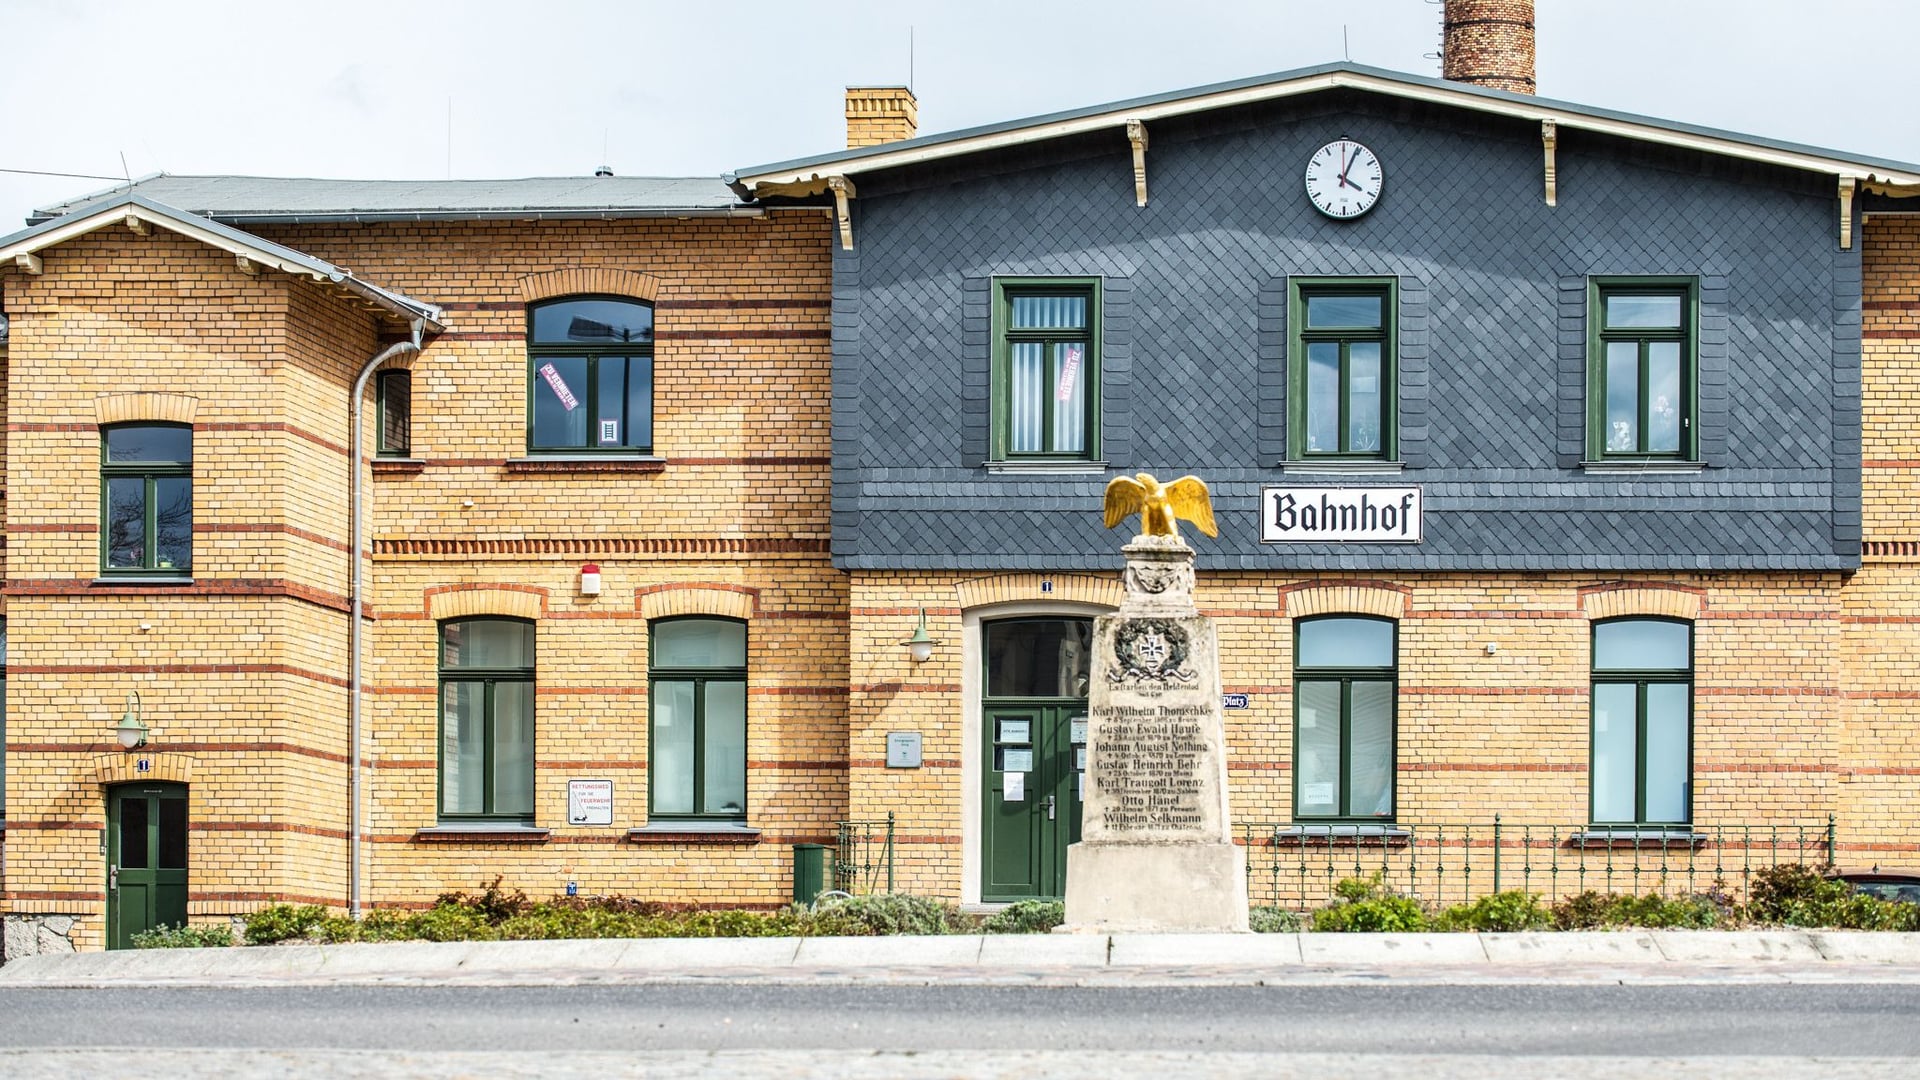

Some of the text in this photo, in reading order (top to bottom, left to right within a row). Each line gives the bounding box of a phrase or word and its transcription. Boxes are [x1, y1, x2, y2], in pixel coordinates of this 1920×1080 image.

[551, 372, 579, 408] VERMIETEN
[1272, 493, 1414, 536] Bahnhof
[1163, 682, 1200, 692] Heldentod
[1223, 696, 1245, 708] Platz
[1092, 706, 1114, 716] Karl
[1115, 706, 1155, 716] Wilhelm
[1099, 724, 1134, 734] Gustav
[1137, 724, 1168, 734] Ewald
[1096, 742, 1130, 752] Johann
[1132, 742, 1168, 752] August
[1096, 760, 1202, 770] Gustav Heinrich Behr
[1097, 777, 1205, 788] Karl Traugott Lorenz
[1122, 796, 1144, 806] Otto
[1104, 813, 1202, 824] Wilhelm Selkmann
